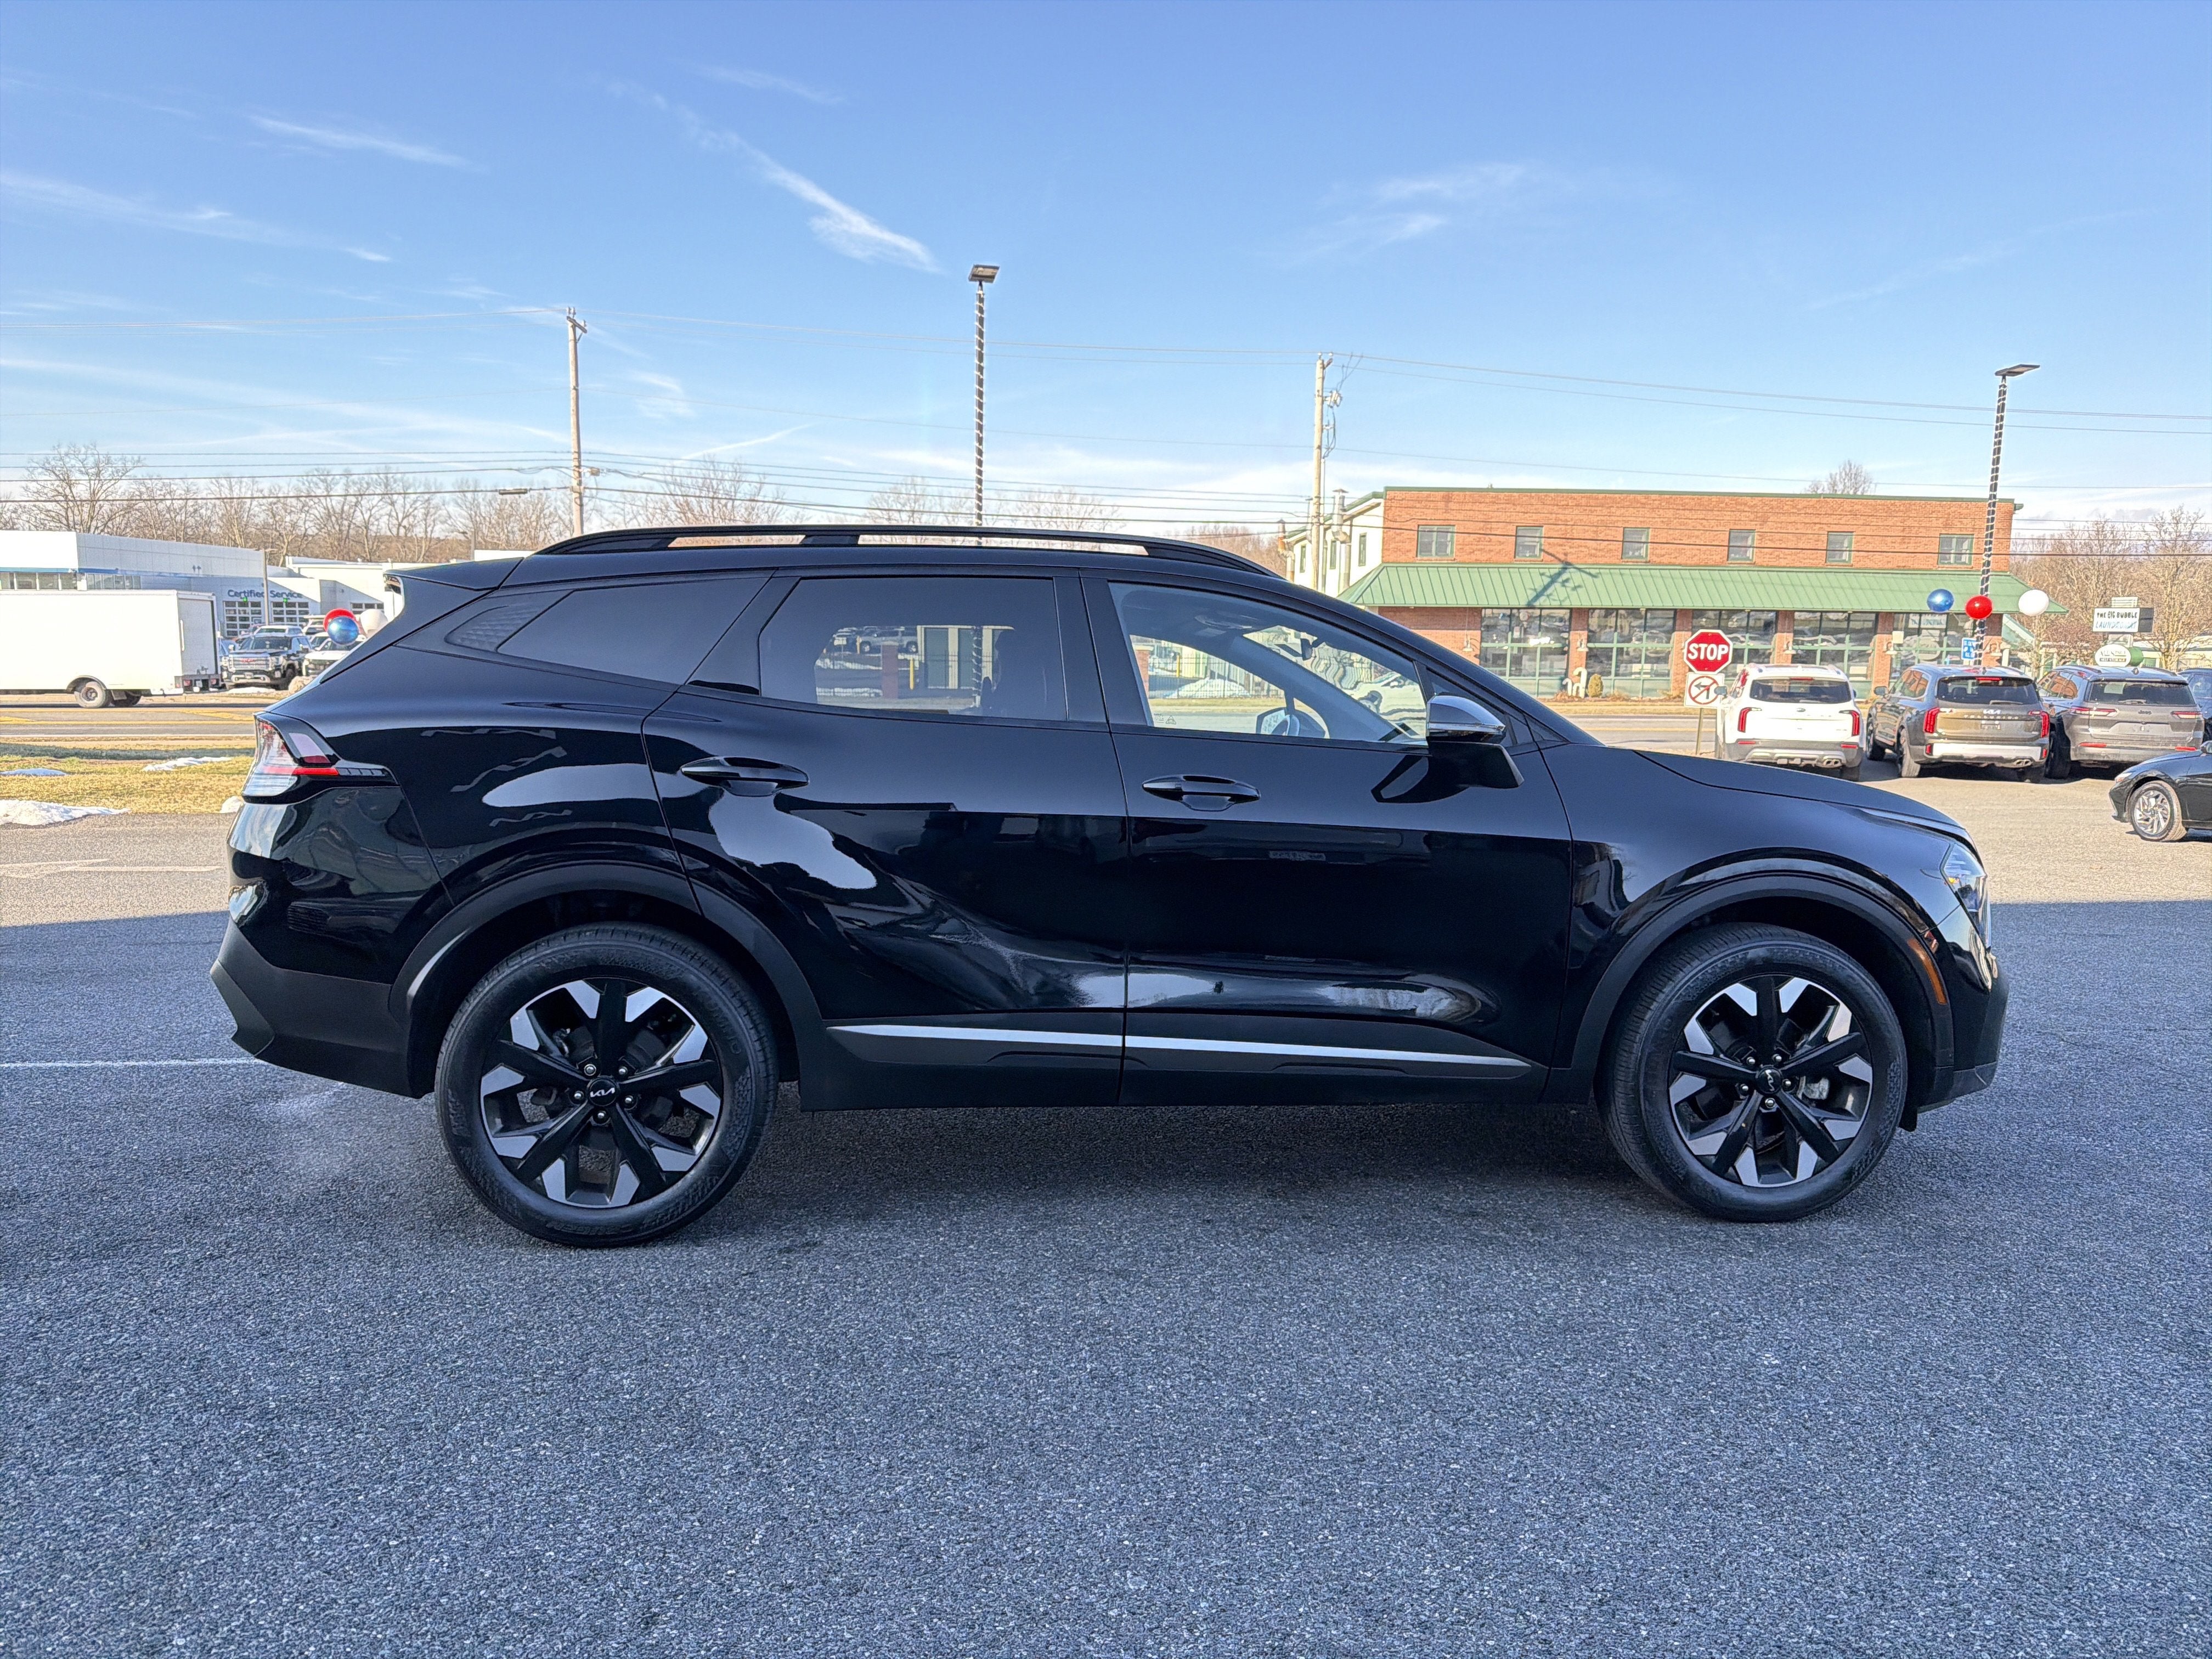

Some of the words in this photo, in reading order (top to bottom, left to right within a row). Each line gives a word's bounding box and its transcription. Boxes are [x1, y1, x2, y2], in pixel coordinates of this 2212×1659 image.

[227, 589, 265, 598] Certified
[270, 590, 302, 599] Service
[1688, 643, 1729, 661] STOP
